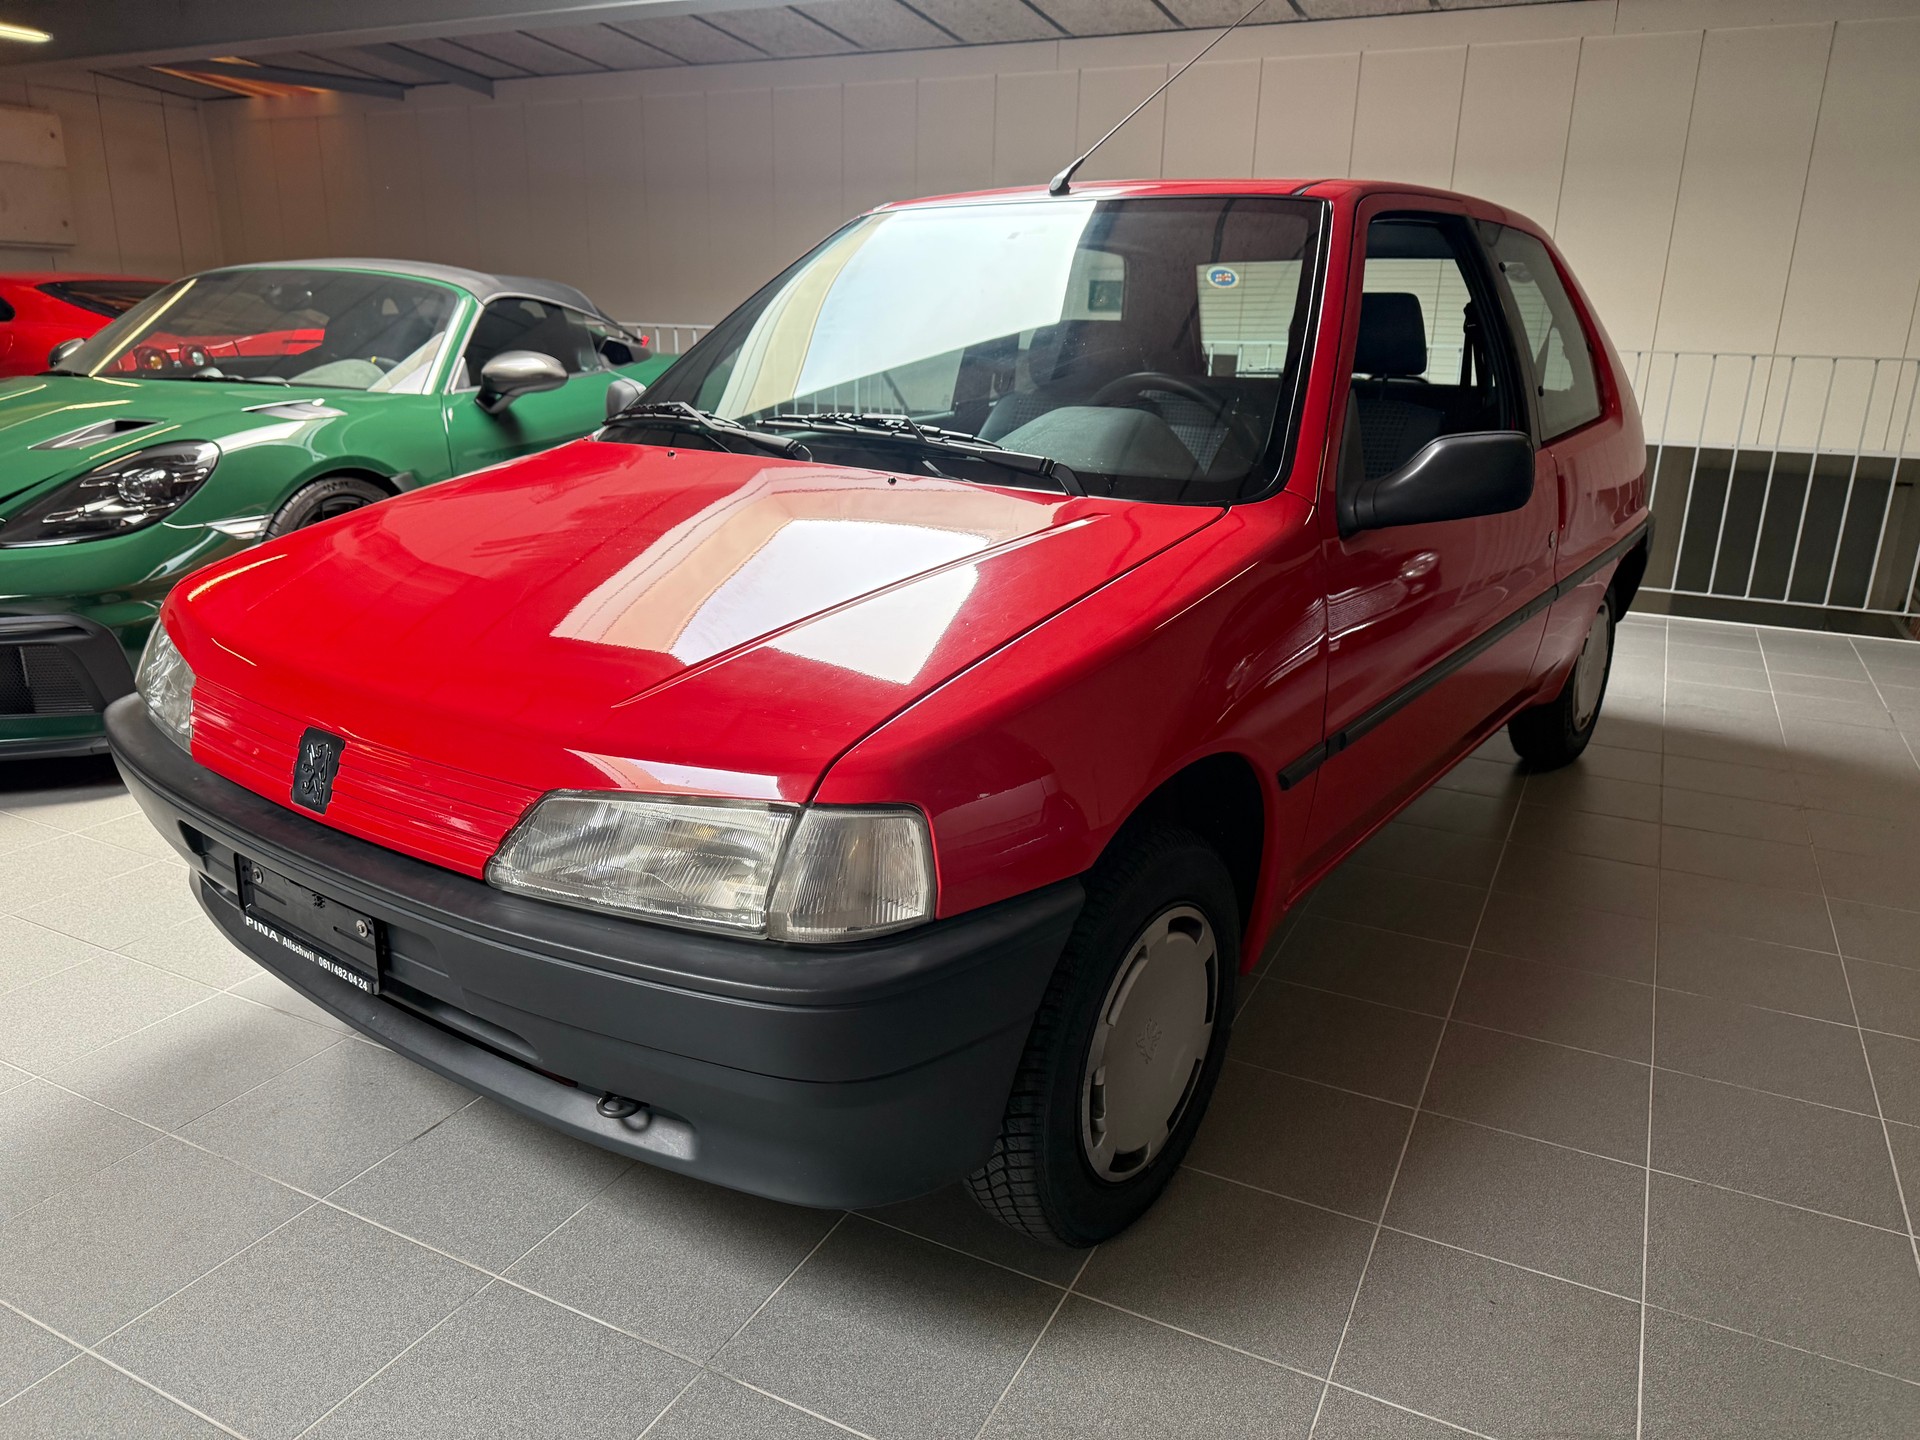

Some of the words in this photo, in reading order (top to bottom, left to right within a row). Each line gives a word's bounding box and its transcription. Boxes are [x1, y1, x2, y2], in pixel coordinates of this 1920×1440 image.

[245, 915, 279, 942] PINA
[282, 936, 315, 962] Allschwil
[318, 956, 348, 980] 061/482
[348, 974, 358, 986] 04
[358, 977, 368, 992] 24
